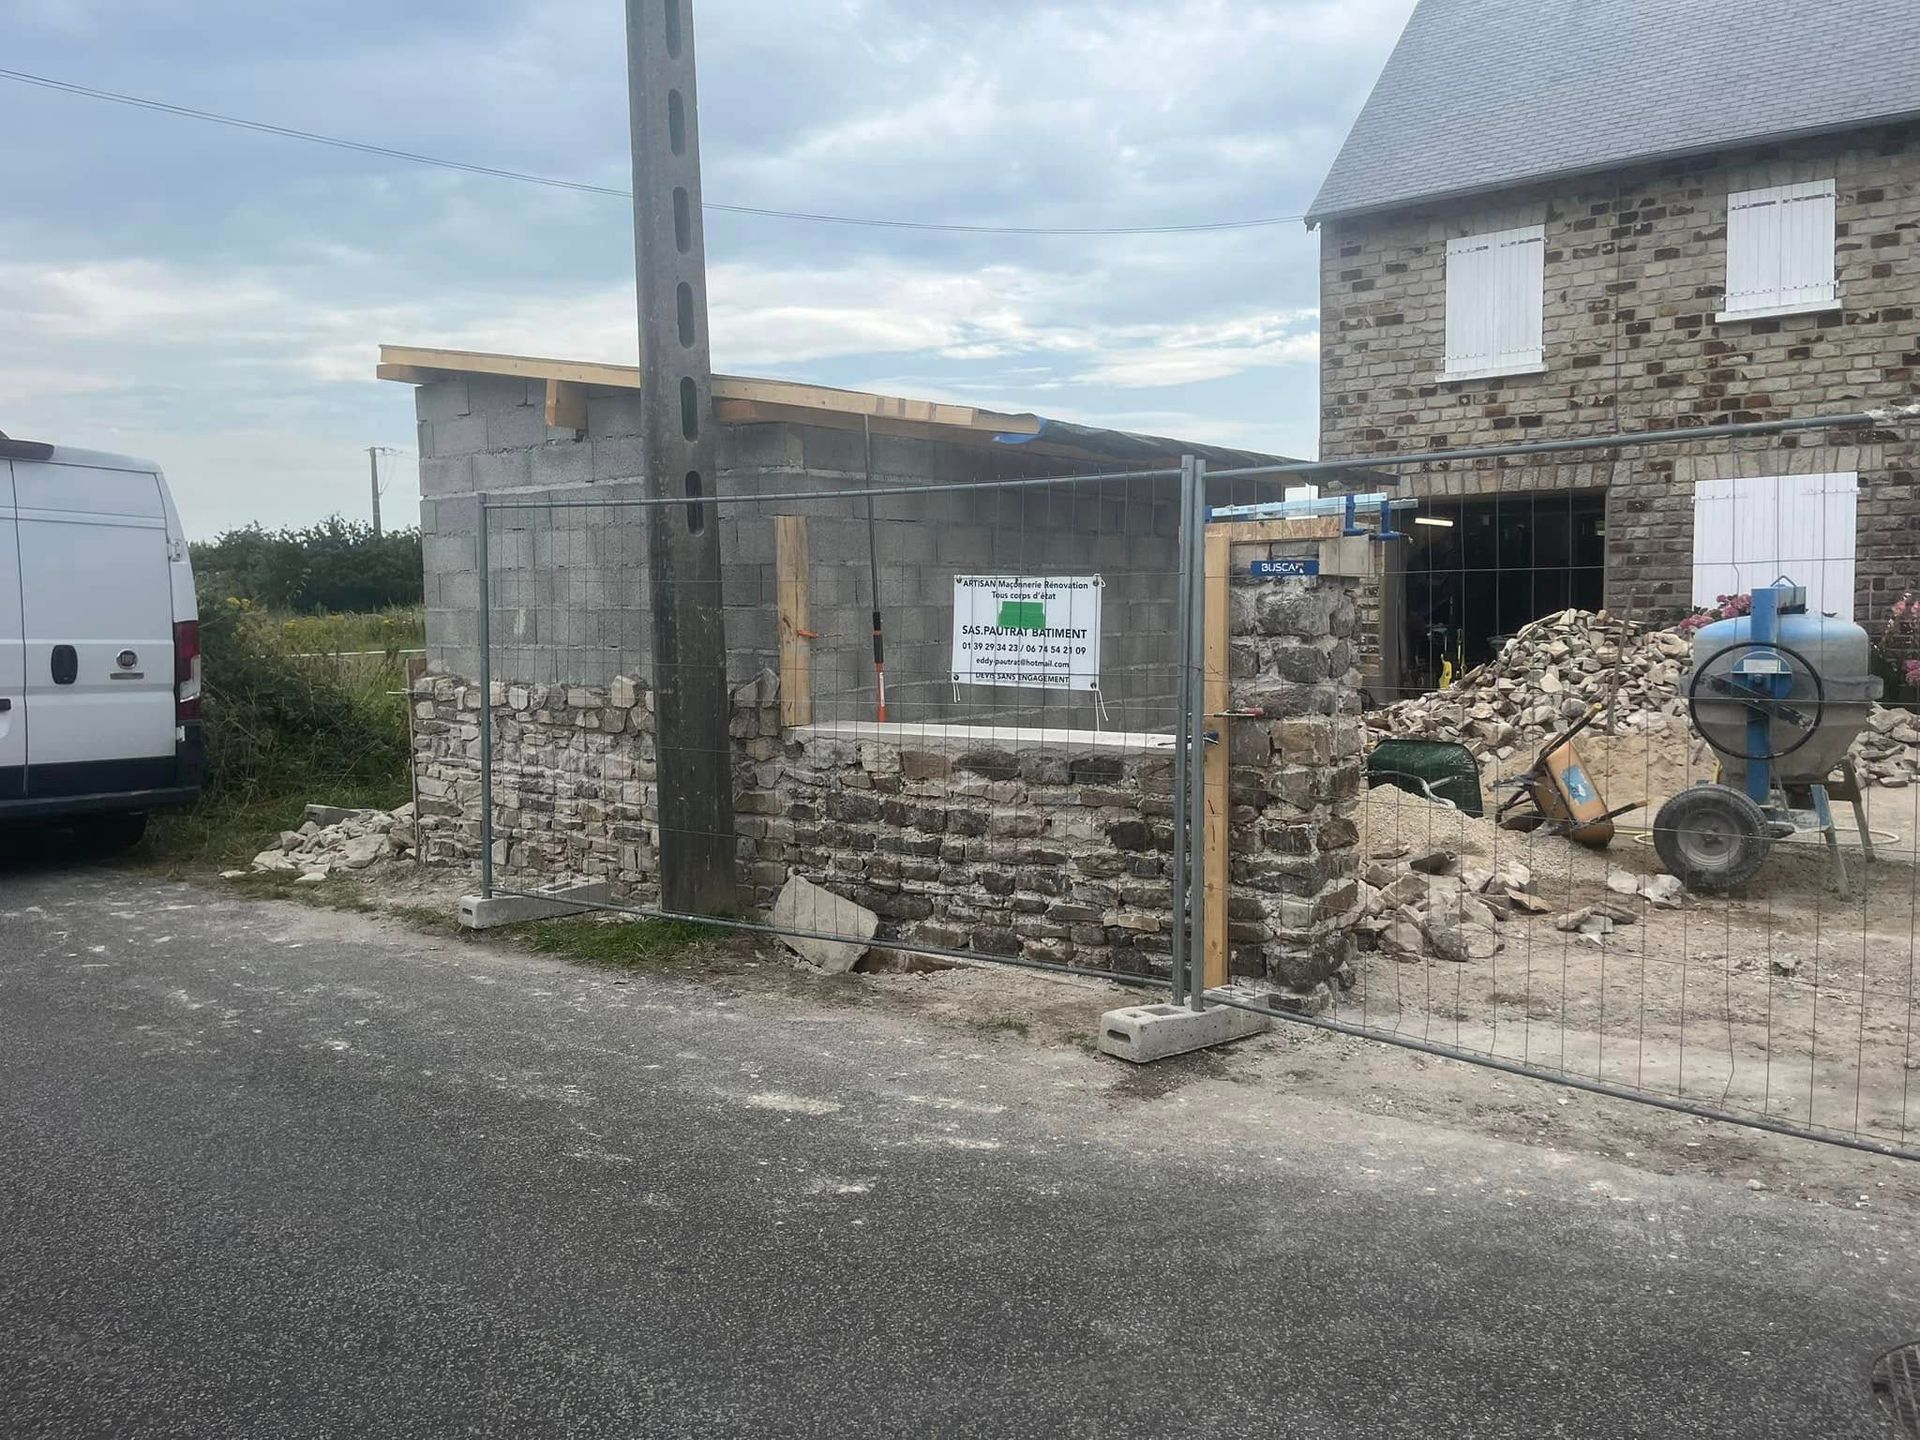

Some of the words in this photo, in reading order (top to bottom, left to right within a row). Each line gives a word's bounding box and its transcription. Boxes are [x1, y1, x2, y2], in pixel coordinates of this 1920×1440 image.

[963, 579, 996, 588] ARTISAN
[998, 580, 1042, 590] Maçonnerie
[1045, 580, 1089, 589] Rénovation
[992, 591, 1008, 599] Tous
[1010, 592, 1031, 600] corps
[1033, 591, 1056, 600] d'état
[962, 641, 971, 650] 01
[973, 642, 983, 650] 39
[985, 643, 995, 651] 29
[996, 643, 1006, 651] 34
[1008, 644, 1018, 652] 23
[1026, 645, 1036, 653] 06
[1038, 645, 1048, 653] 74
[1050, 646, 1060, 654] 54
[1063, 646, 1073, 654] 21
[1075, 646, 1087, 655] 09
[975, 672, 995, 680] DEVIS
[996, 673, 1017, 681] SANS
[1018, 673, 1070, 683] ENGAGEMENT
